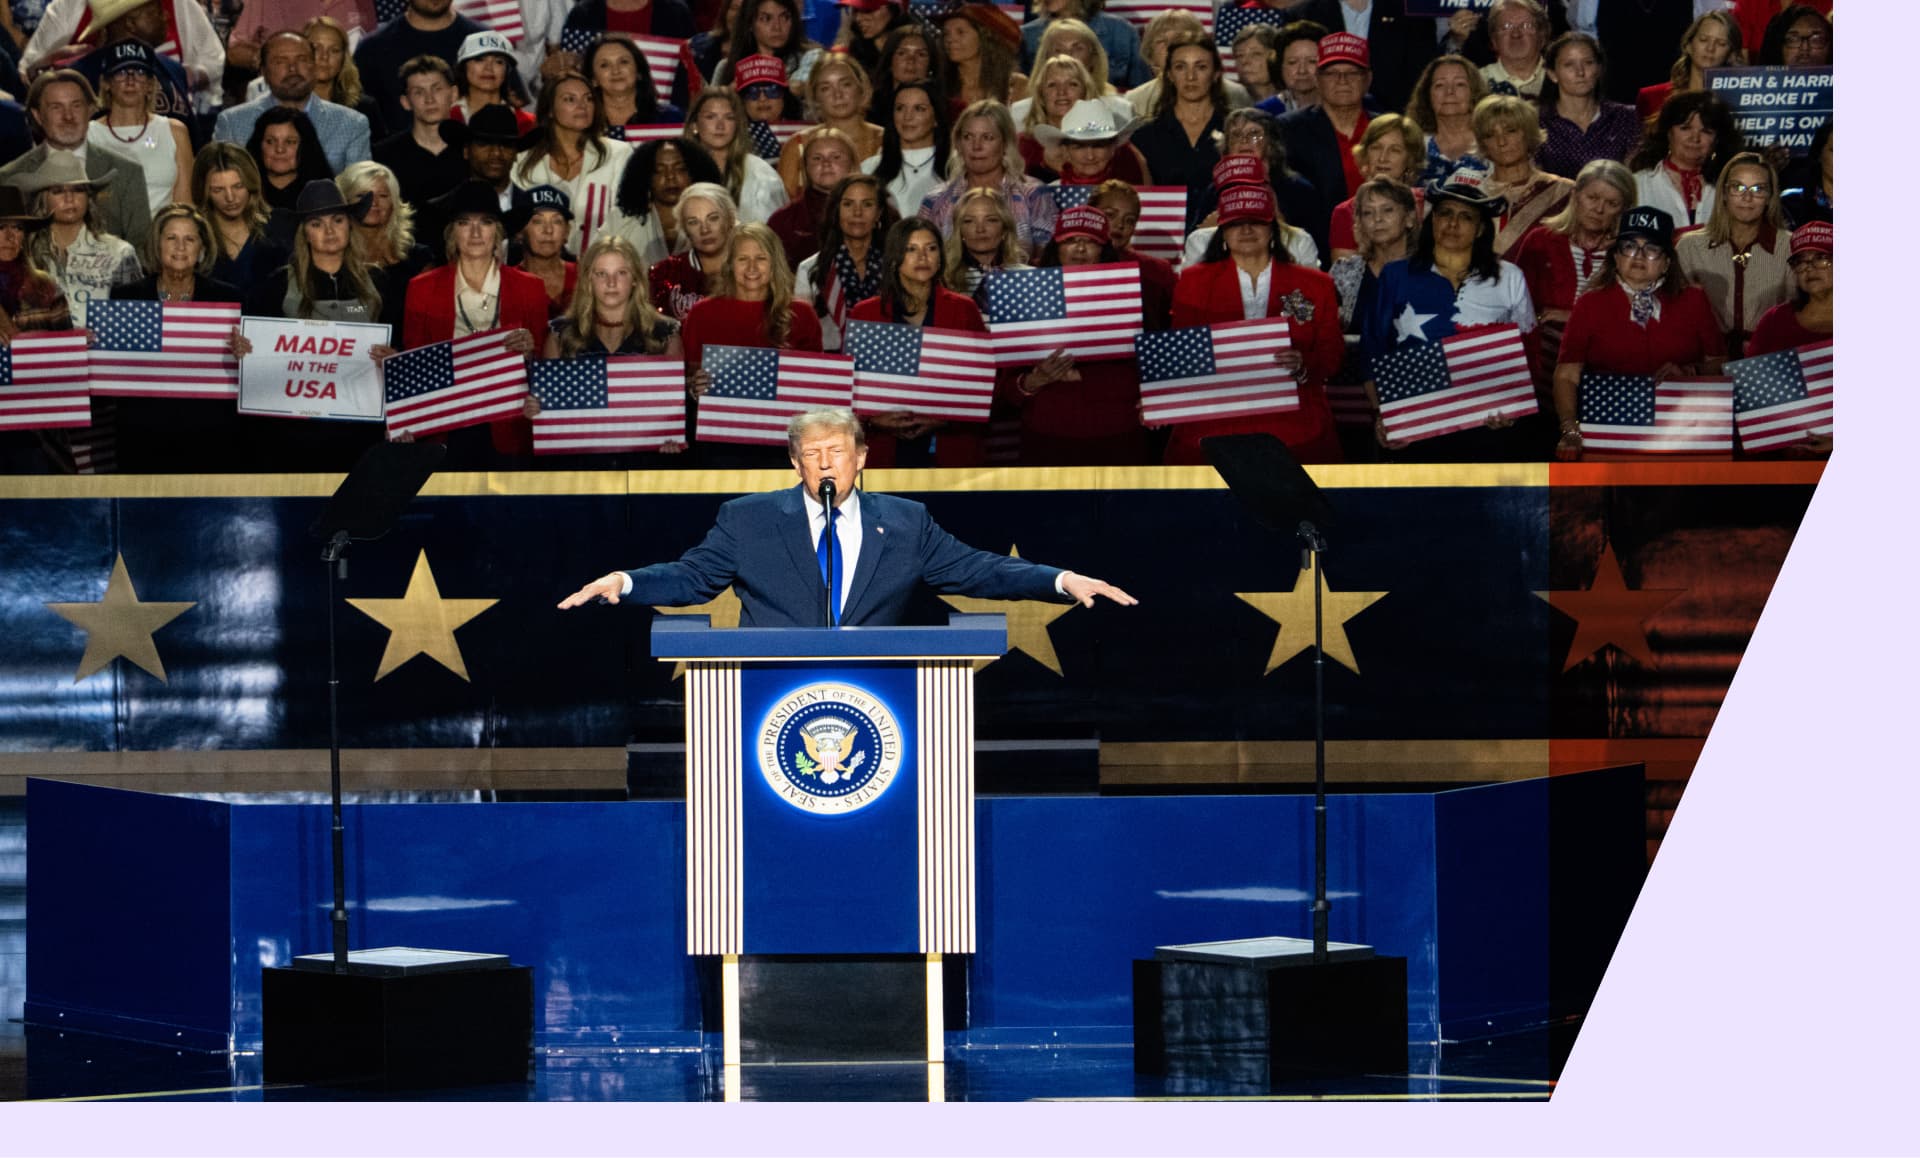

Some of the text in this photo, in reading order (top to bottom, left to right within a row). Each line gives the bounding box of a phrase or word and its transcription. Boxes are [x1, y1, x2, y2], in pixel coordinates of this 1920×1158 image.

[479, 37, 507, 50] USA
[115, 44, 147, 59] USA
[1712, 77, 1763, 90] BIDEN
[1765, 76, 1778, 88] &
[1739, 92, 1819, 106] BROKE IT
[1733, 116, 1825, 131] HELP IS ON
[1743, 134, 1816, 147] THE WAY
[1455, 175, 1482, 186] TRUMP
[532, 190, 564, 206] USA
[1628, 213, 1659, 231] USA
[274, 334, 356, 357] MADE
[287, 360, 338, 374] IN THE
[285, 379, 337, 400] USA
[832, 691, 846, 700] OF
[849, 694, 867, 708] THE
[764, 689, 828, 746] PRESIDENT
[868, 705, 896, 761] UNITED
[764, 749, 774, 767] THE
[770, 769, 782, 782] OF
[782, 782, 817, 808] SEAL
[844, 767, 891, 808] STATES
